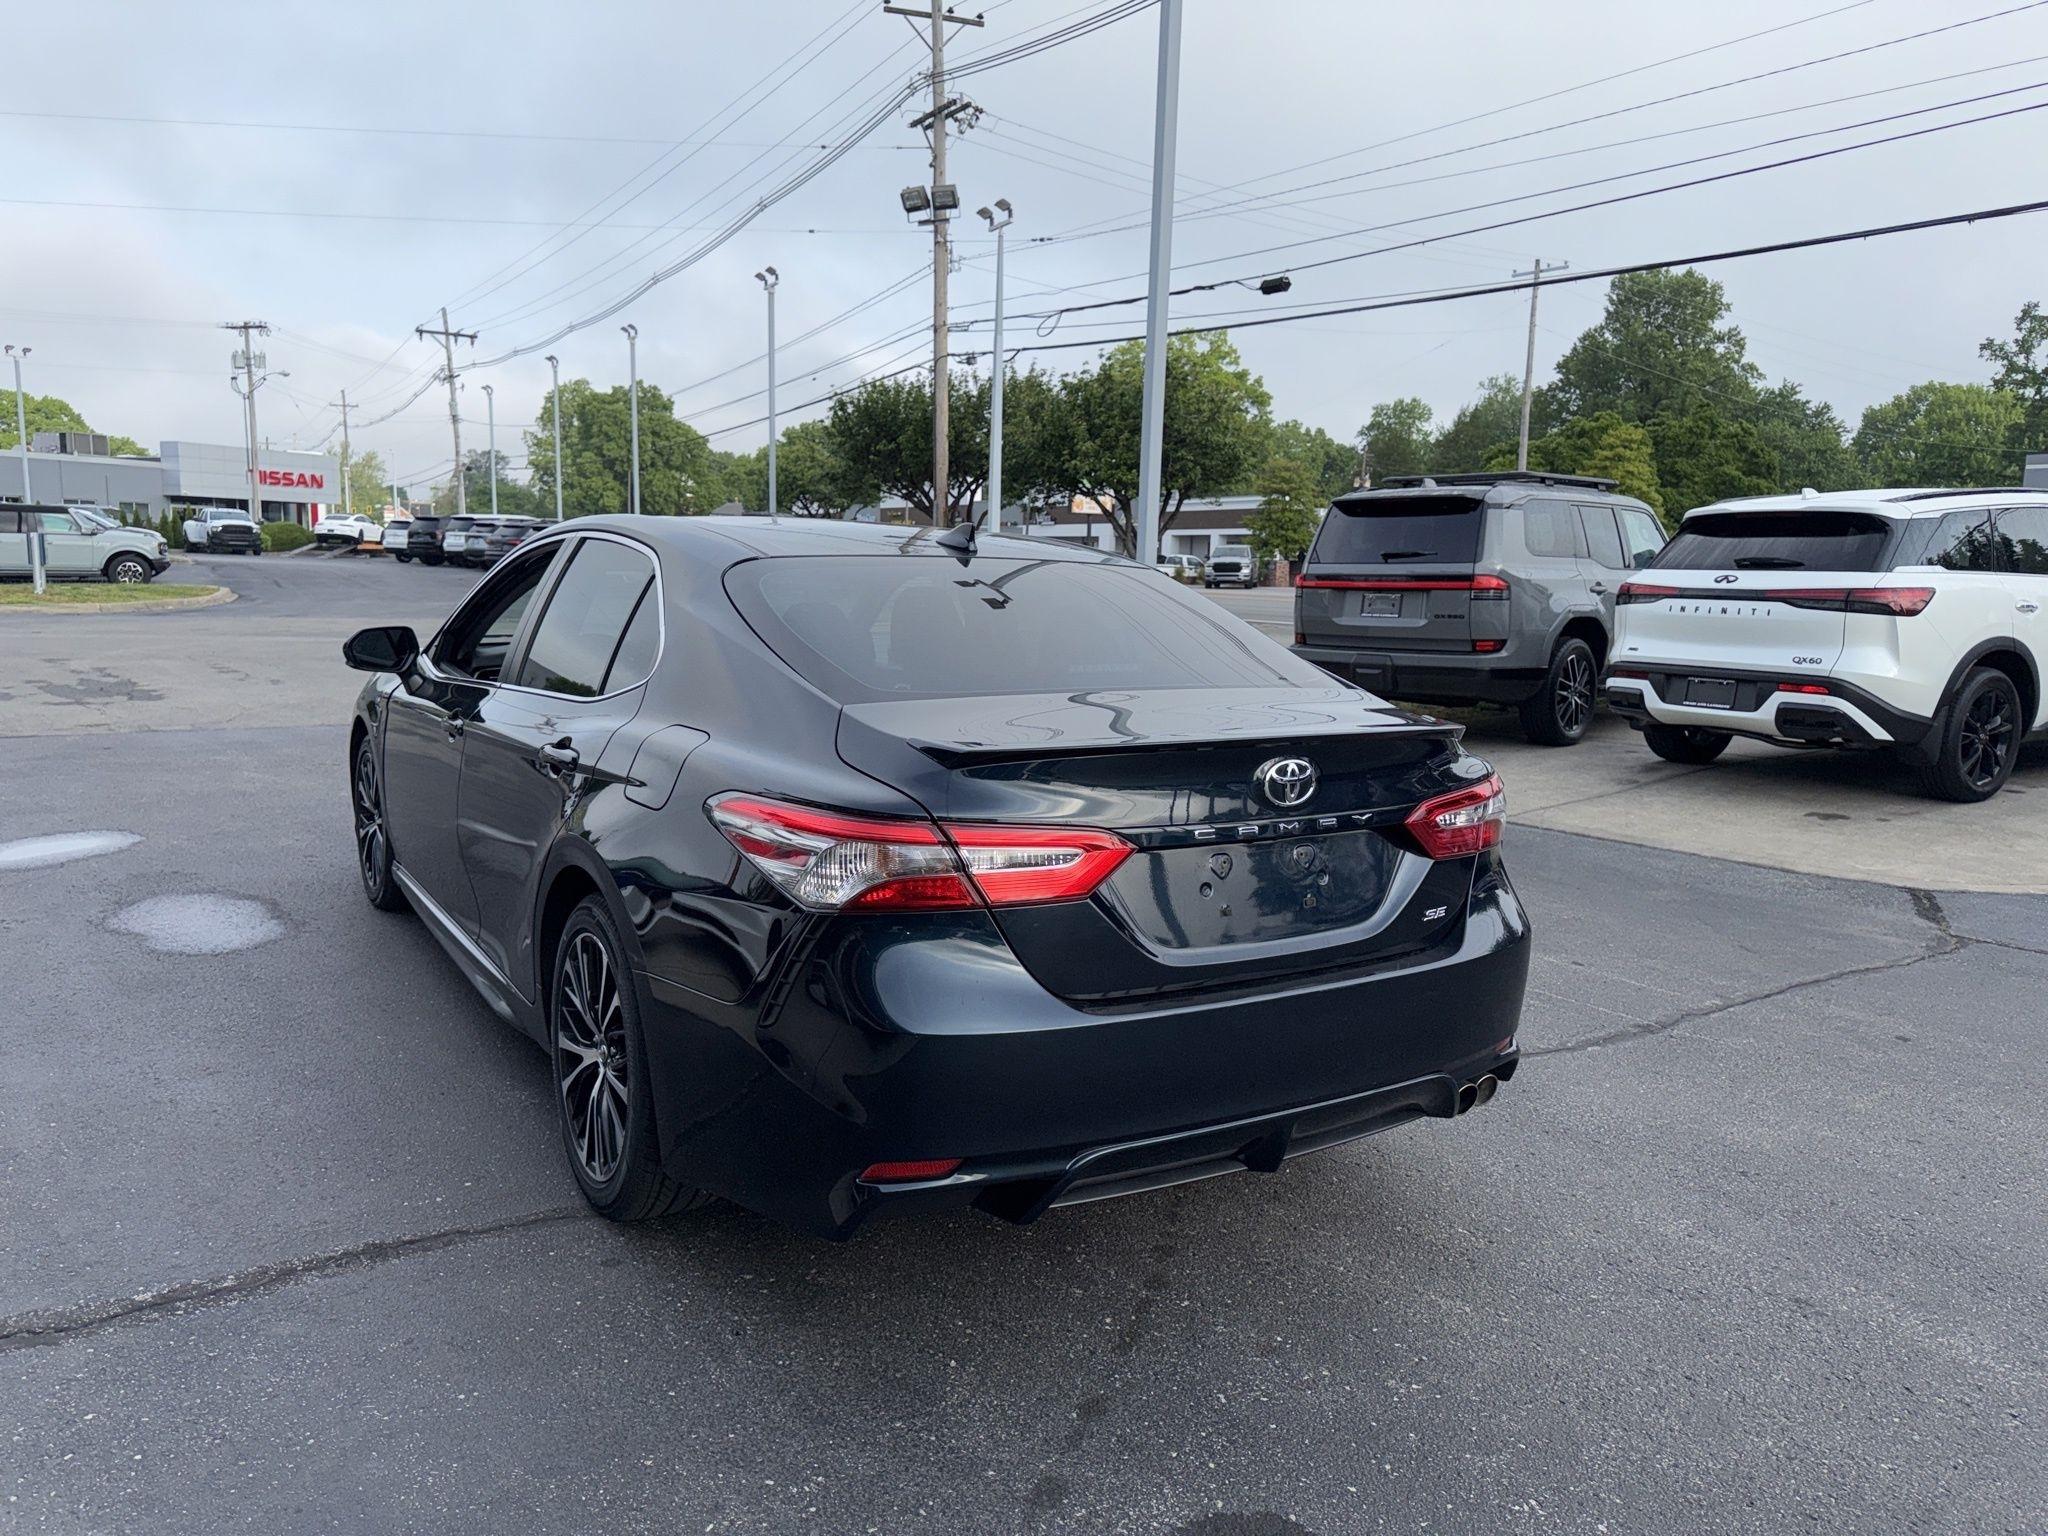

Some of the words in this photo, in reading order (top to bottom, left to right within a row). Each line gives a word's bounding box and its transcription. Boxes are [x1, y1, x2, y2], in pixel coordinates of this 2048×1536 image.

[1669, 605, 1771, 616] INFINITI
[1792, 656, 1823, 665] QX60
[1194, 813, 1373, 839] CAMRY
[1423, 906, 1447, 921] SE
